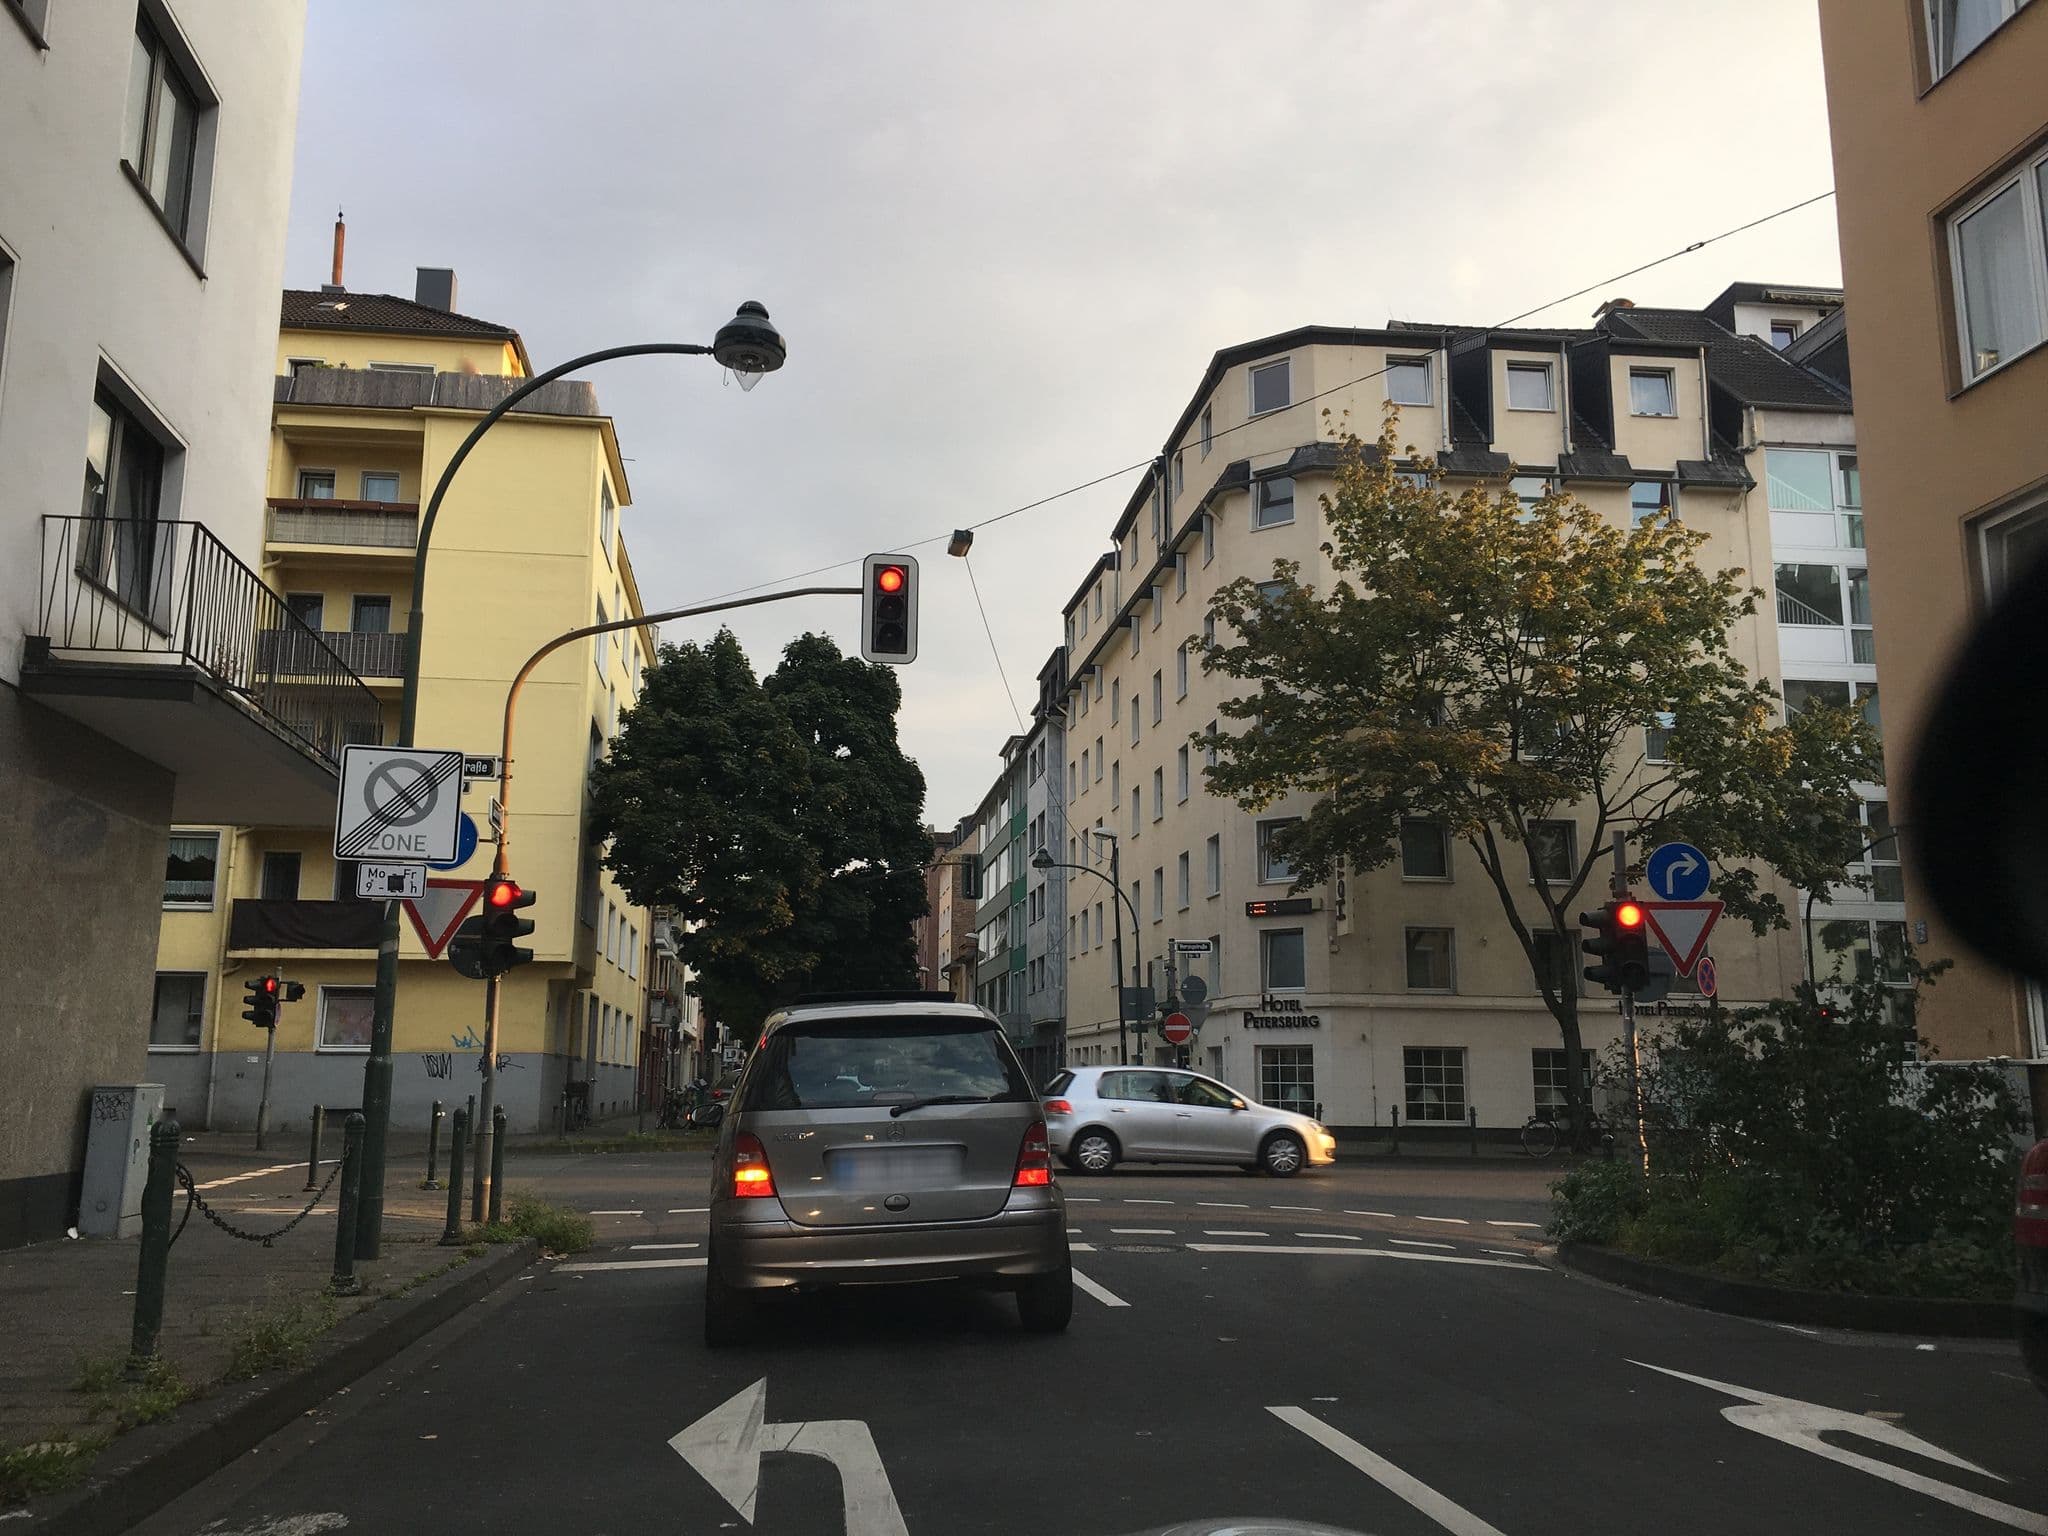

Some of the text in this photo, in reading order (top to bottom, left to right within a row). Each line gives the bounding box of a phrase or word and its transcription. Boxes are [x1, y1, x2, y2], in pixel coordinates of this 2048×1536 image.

[367, 832, 427, 852] ZONE
[367, 867, 386, 879] Mo
[403, 868, 417, 880] Fr
[365, 881, 373, 893] 9
[410, 880, 418, 893] h
[1243, 1011, 1321, 1029] PETERSBURG
